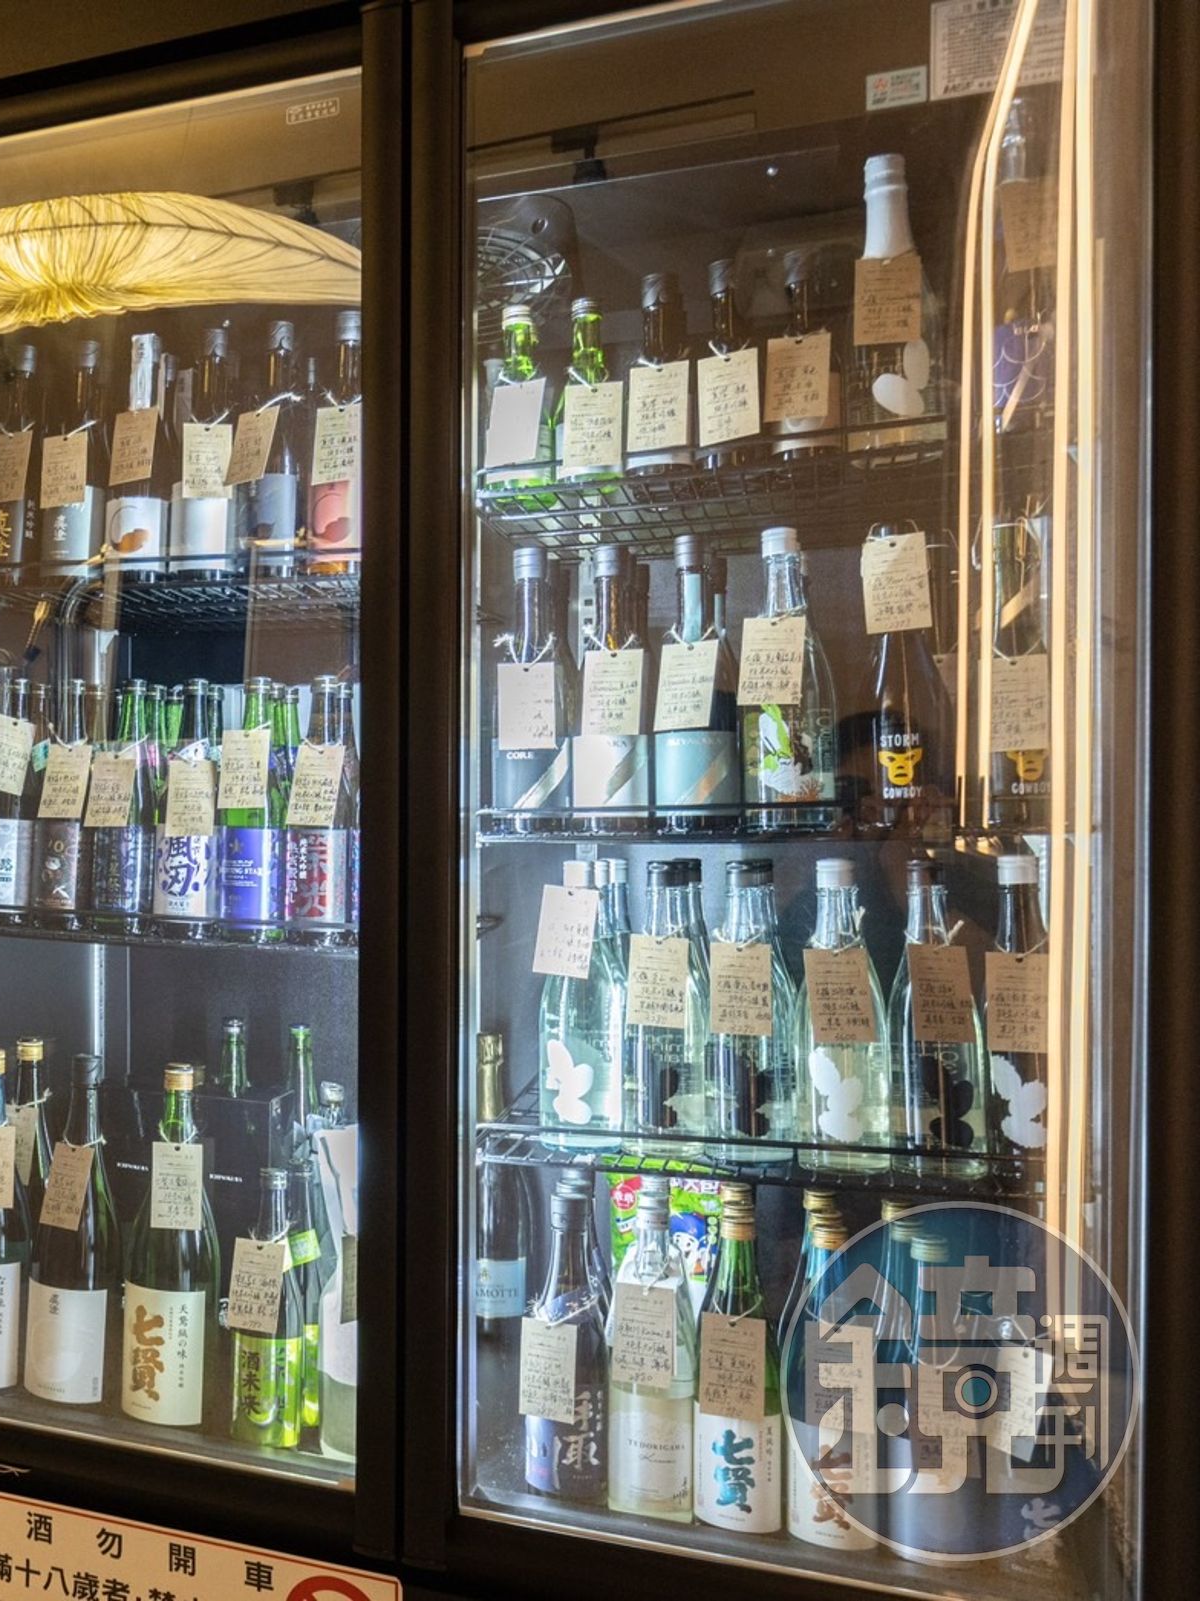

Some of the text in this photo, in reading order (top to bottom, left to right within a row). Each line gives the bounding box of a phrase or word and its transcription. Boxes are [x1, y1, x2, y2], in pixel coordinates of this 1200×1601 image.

[880, 733, 919, 748] STORM
[883, 786, 922, 799] COWBOY
[130, 1304, 165, 1402] 七賢
[711, 1428, 756, 1514] 七賢
